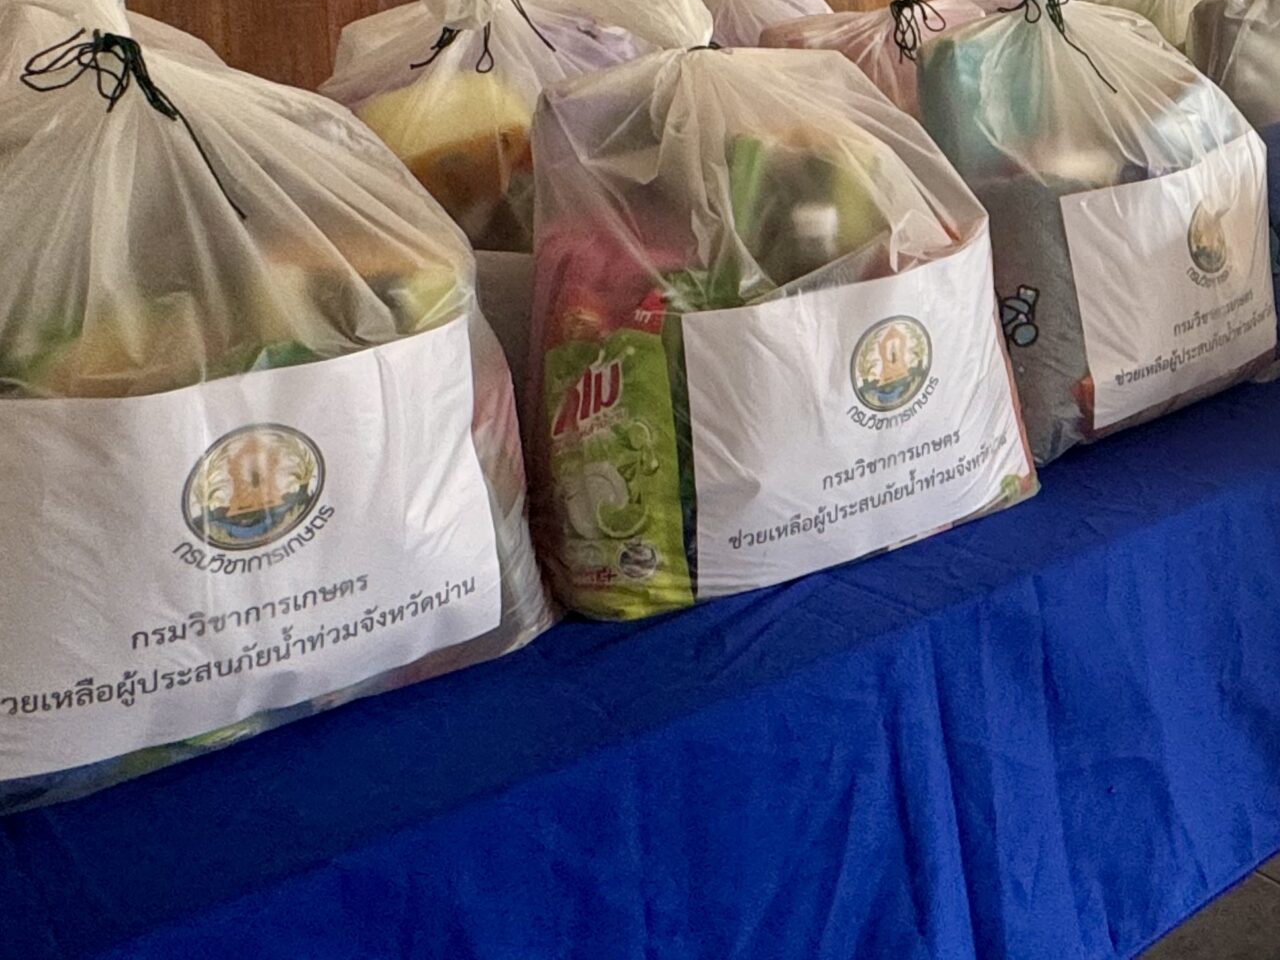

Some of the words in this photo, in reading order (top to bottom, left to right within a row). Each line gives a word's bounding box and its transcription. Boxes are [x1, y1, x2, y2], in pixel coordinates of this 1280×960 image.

[845, 375, 940, 431] กรมวิชาการเกษตร
[822, 429, 961, 490] กรมวิชาการเกษตร
[171, 502, 336, 576] กรมวิชาการเกษตร
[131, 572, 370, 650] กรมวิชาการเกษตร
